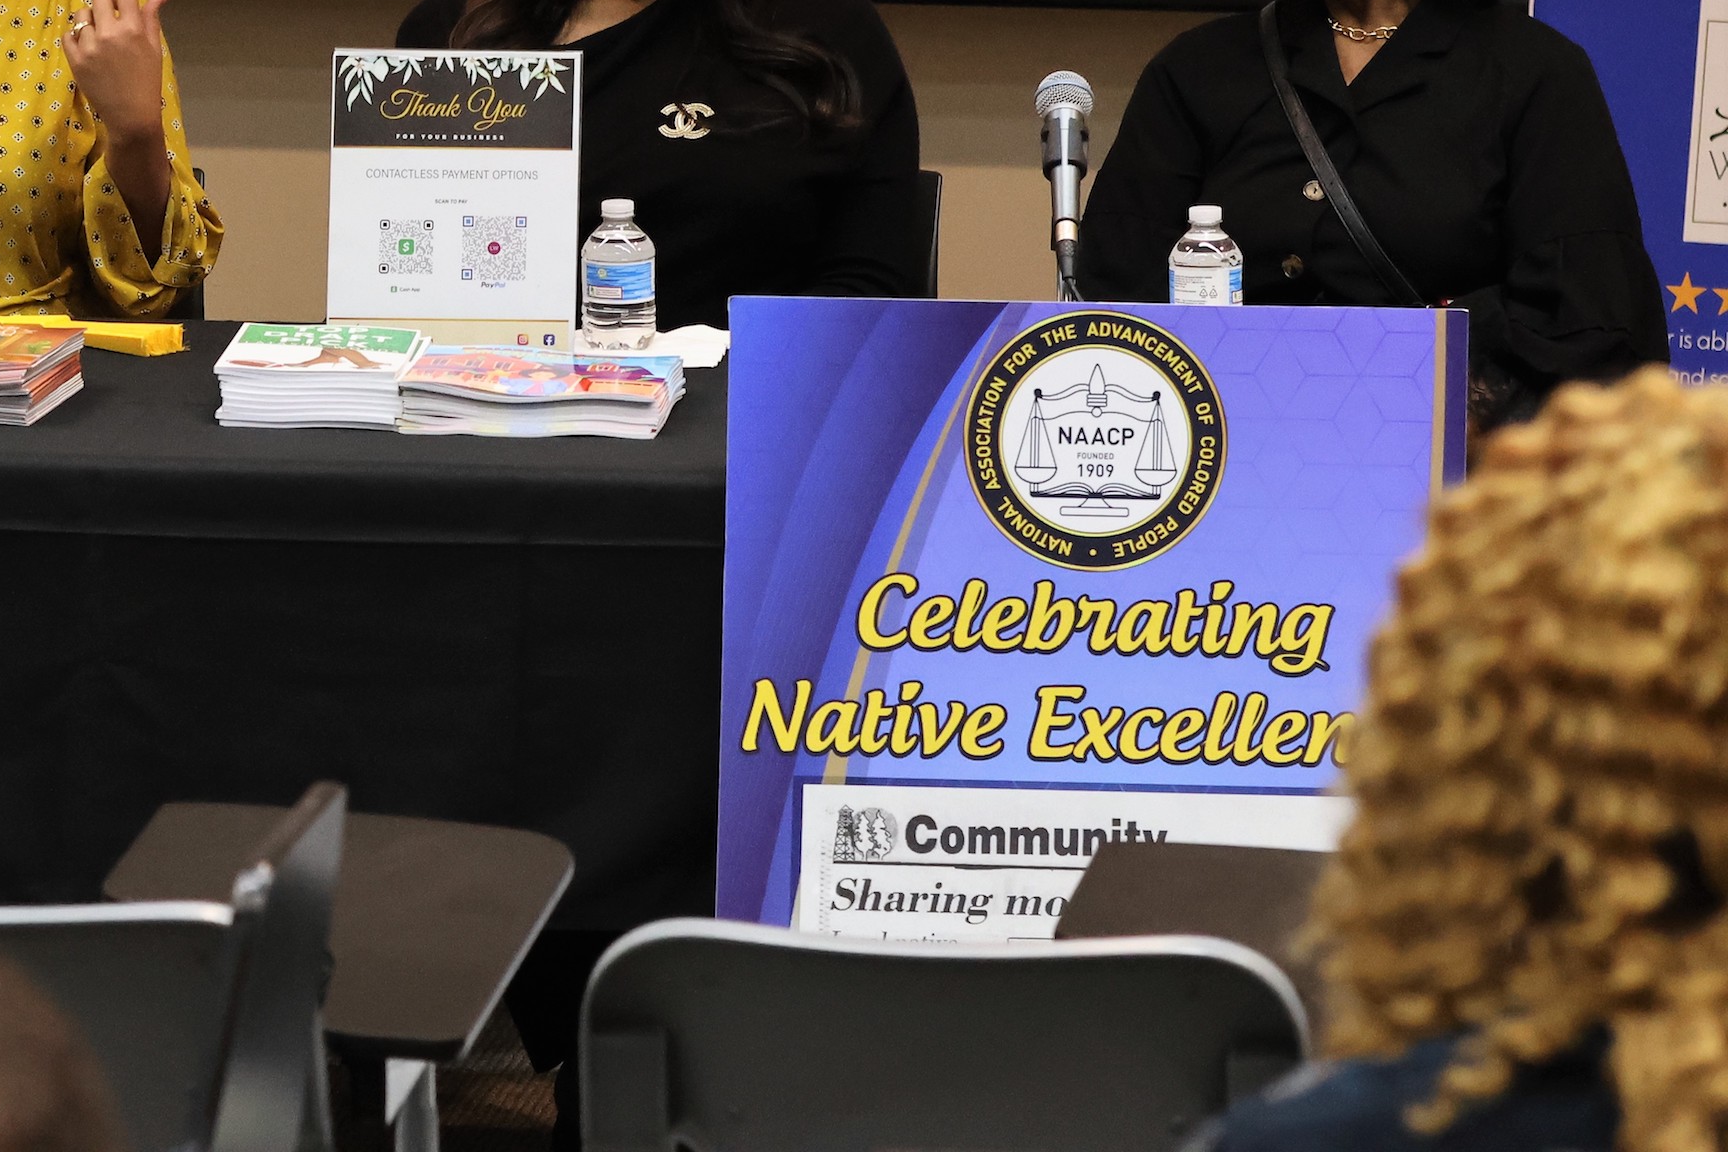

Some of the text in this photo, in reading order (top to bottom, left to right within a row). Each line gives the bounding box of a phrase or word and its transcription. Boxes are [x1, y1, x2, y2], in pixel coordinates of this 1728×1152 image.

[380, 86, 527, 131] Thank You
[365, 168, 539, 181] CONTACTLESS PAYMENT OPTIONS
[1679, 329, 1692, 349] is
[975, 321, 1216, 558] NATIONAL ASSOCIATION FOR THE ADVANCEMENT OF COLORED PEOPLE
[1058, 426, 1134, 446] NAACP
[1076, 452, 1114, 460] FOUNDED
[1078, 463, 1114, 478] 1909
[856, 571, 1334, 676] Celebrating
[741, 678, 1355, 768] Native Excellen
[830, 877, 993, 925] Sharing
